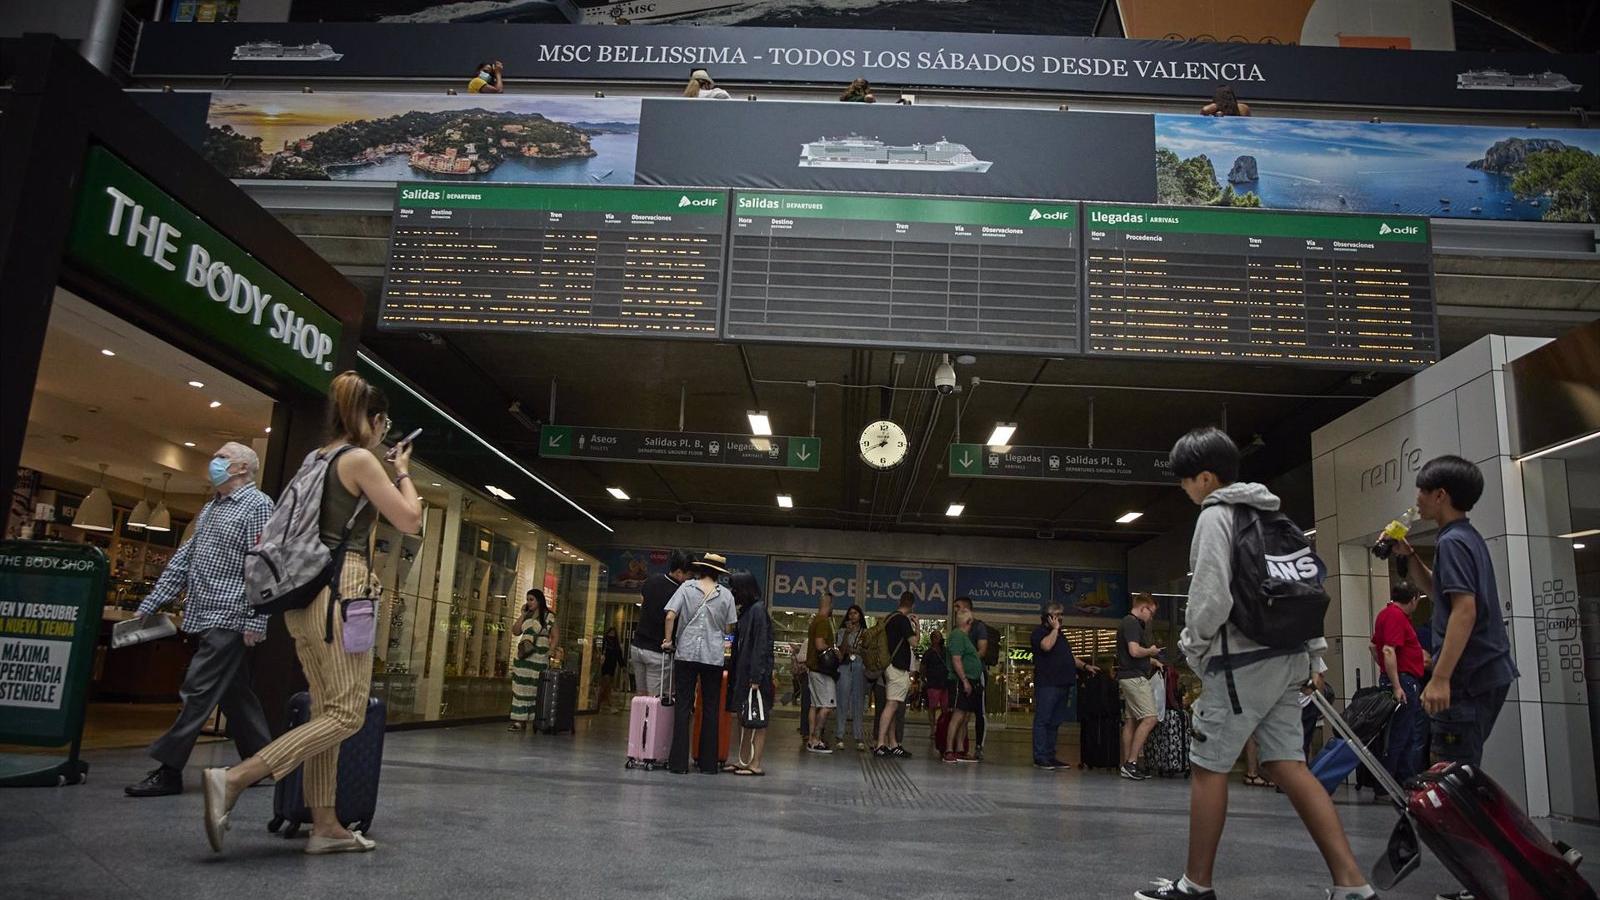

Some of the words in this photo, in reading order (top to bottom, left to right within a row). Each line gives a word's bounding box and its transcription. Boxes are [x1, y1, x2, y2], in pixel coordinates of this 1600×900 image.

[627, 4, 657, 16] MSC
[538, 44, 592, 63] MSC
[596, 45, 748, 65] BELLISSIMA
[768, 47, 856, 67] TODOS
[862, 50, 911, 69] LOS
[917, 48, 1036, 74] SÁBADOS
[1042, 57, 1129, 77] DESDE
[1132, 60, 1266, 82] VALENCIA
[402, 189, 440, 201] Salidas
[446, 193, 482, 201] DEPARTURES
[691, 198, 718, 207] adif
[739, 198, 779, 209] Salidas
[786, 202, 823, 210] DEPARTURES
[631, 214, 672, 223] Observaciones
[1042, 211, 1069, 220] adif
[1092, 212, 1143, 225] Llegadas
[1150, 216, 1179, 225] ARRIVALS
[982, 226, 1023, 235] Observaciones
[1392, 226, 1419, 235] adif
[1126, 234, 1163, 243] Procedencia
[1333, 241, 1375, 250] Observaciones
[106, 186, 182, 271] THE
[185, 243, 272, 326] BODY
[590, 434, 617, 445] Aseos
[644, 437, 676, 448] Salidas
[679, 439, 691, 448] Pl.
[694, 440, 704, 449] B.
[1004, 454, 1041, 466] Llegadas
[1065, 456, 1099, 466] Salidas
[1101, 457, 1113, 466] Pl.
[1116, 457, 1126, 467] B.
[1153, 459, 1170, 469] Ase
[1360, 438, 1423, 493] renfe
[0, 554, 23, 567] THE
[24, 556, 61, 569] BODY
[774, 574, 946, 602] BARCELONA
[984, 580, 1010, 591] VIAJA
[1011, 582, 1024, 592] EN
[968, 589, 990, 598] ALTA
[991, 590, 1042, 600] VELOCIDAD
[17, 602, 26, 617] Y
[23, 602, 80, 621] DESCUBRE
[6, 616, 40, 635] NUEVA
[40, 619, 75, 637] TIENDA
[1, 641, 50, 664] MÁXIMA
[0, 662, 62, 684] PERIENCIA
